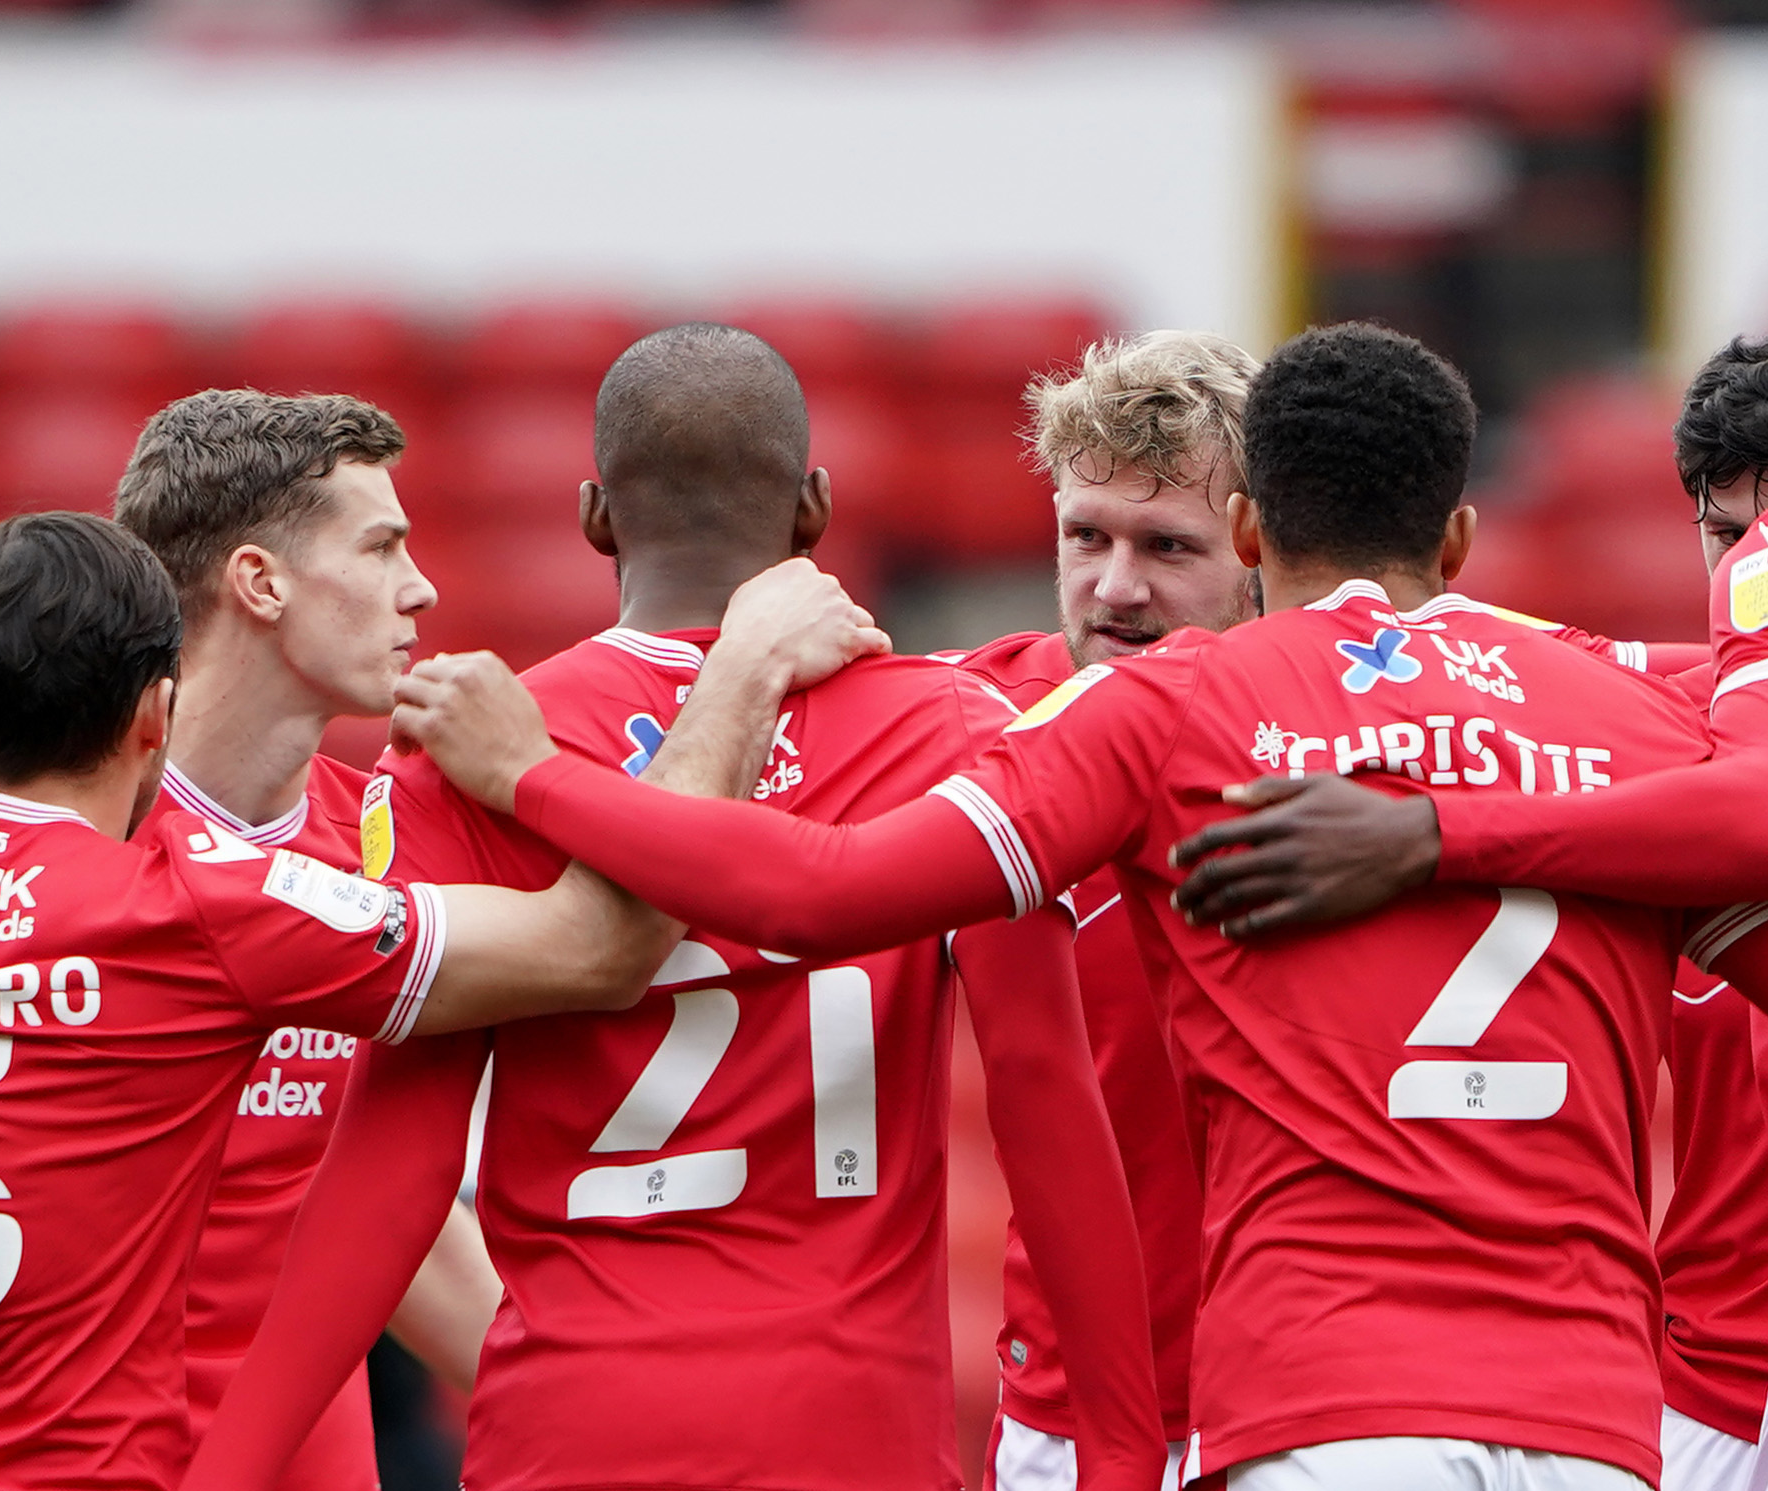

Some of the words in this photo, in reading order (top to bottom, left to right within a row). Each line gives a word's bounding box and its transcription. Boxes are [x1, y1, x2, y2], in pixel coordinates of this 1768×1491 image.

[1429, 633, 1518, 680] UK
[1443, 659, 1526, 704] Meds
[753, 760, 804, 800] eds
[1388, 887, 1568, 1119] 2
[568, 939, 879, 1220] 21
[1466, 1097, 1485, 1108] EFL
[647, 1194, 665, 1205] EFL
[837, 1176, 858, 1187] EFL
